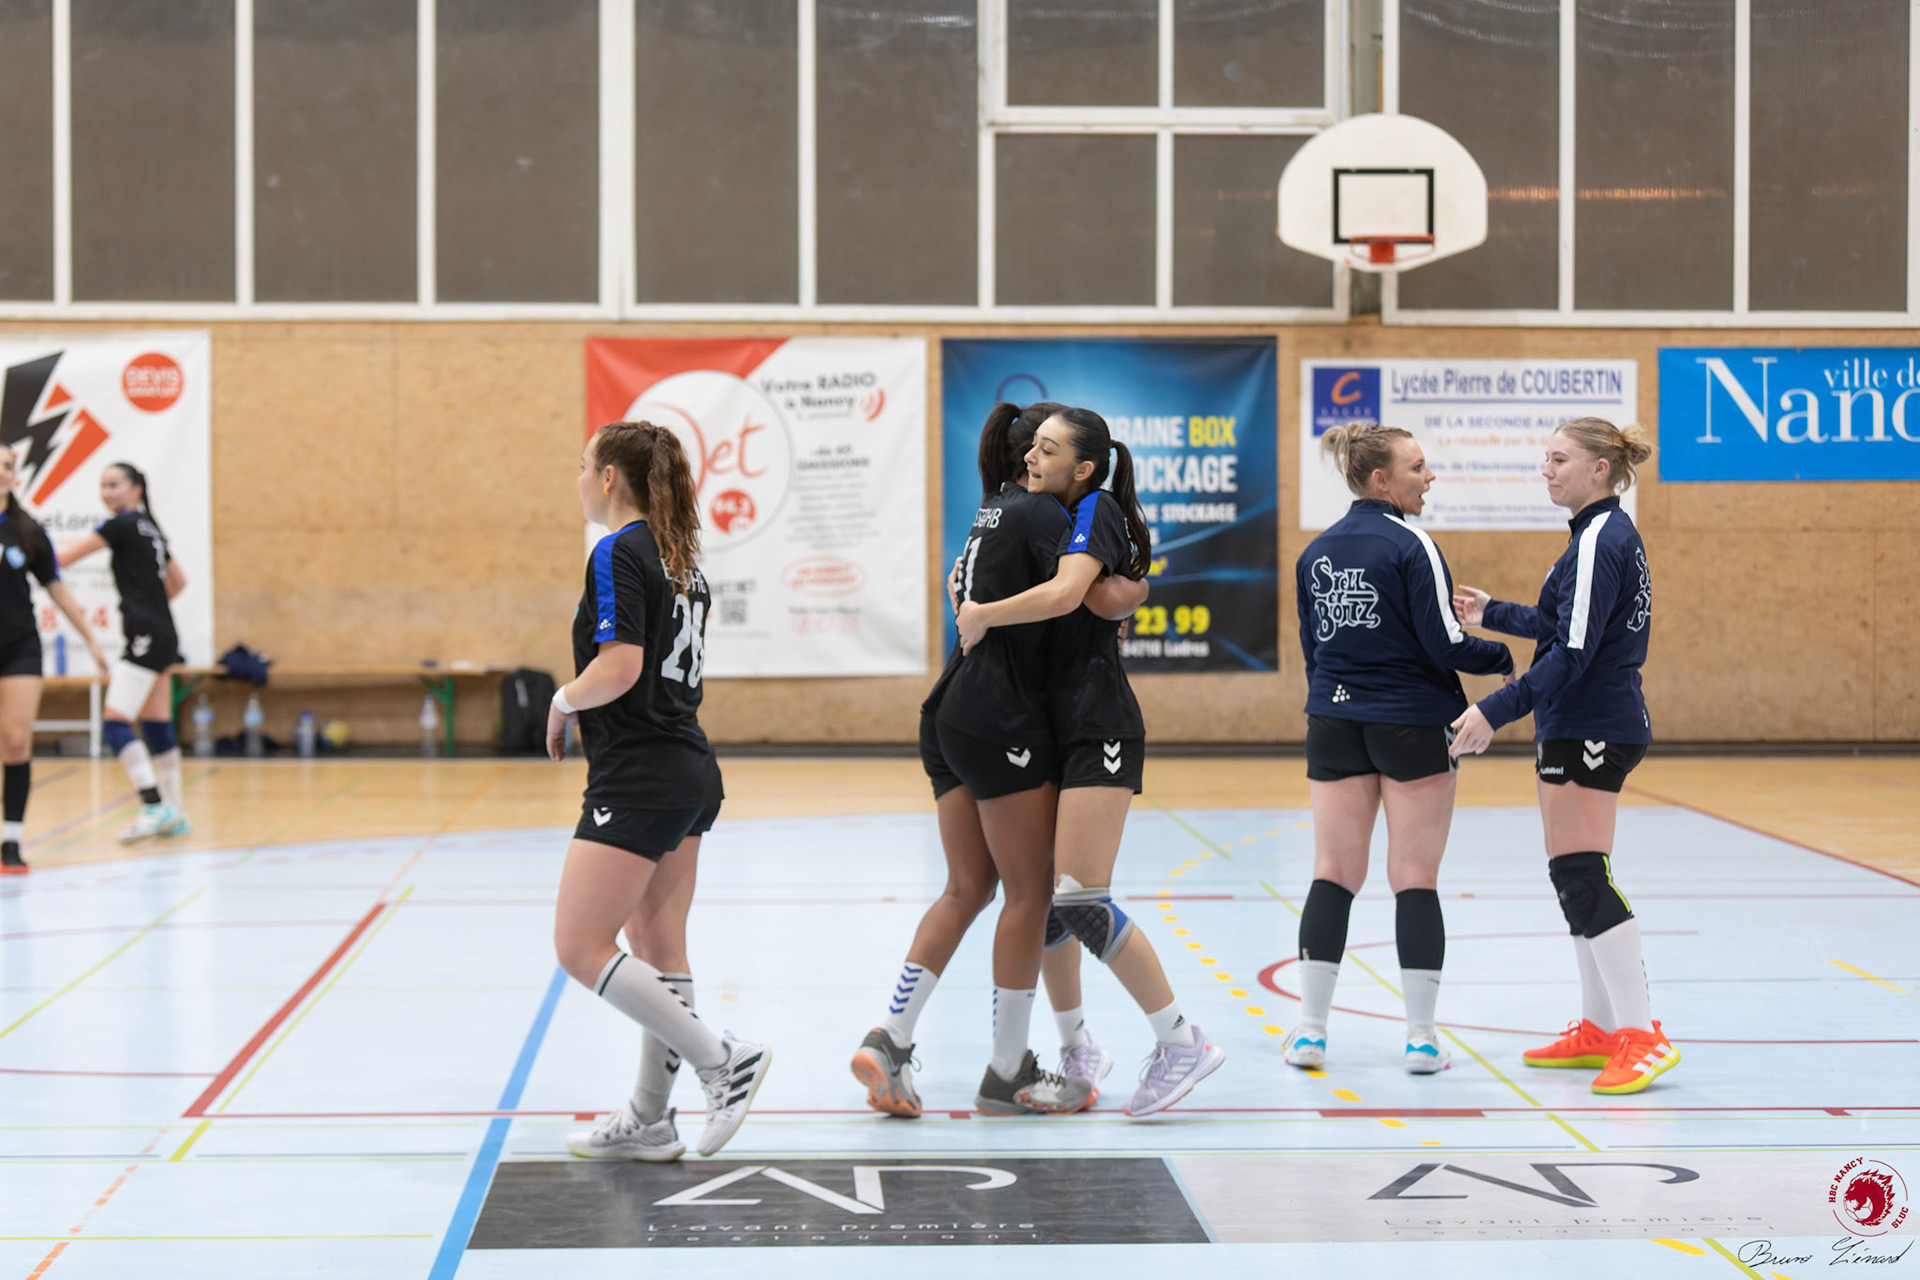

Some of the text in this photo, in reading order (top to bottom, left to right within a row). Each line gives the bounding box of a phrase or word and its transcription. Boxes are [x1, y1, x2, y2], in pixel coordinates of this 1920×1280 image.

[816, 372, 877, 389] RADIO
[1392, 369, 1622, 400] Lycée Pierre de COUBERTIN
[1824, 357, 1920, 388] ville d
[1188, 416, 1236, 447] BOX
[1446, 416, 1463, 428] LA
[1469, 416, 1530, 428] SECONDE
[1161, 503, 1237, 523] STOCKAGE
[1134, 605, 1210, 635] 23 99
[661, 593, 704, 689] 26
[648, 1222, 1035, 1232] L'avant première
